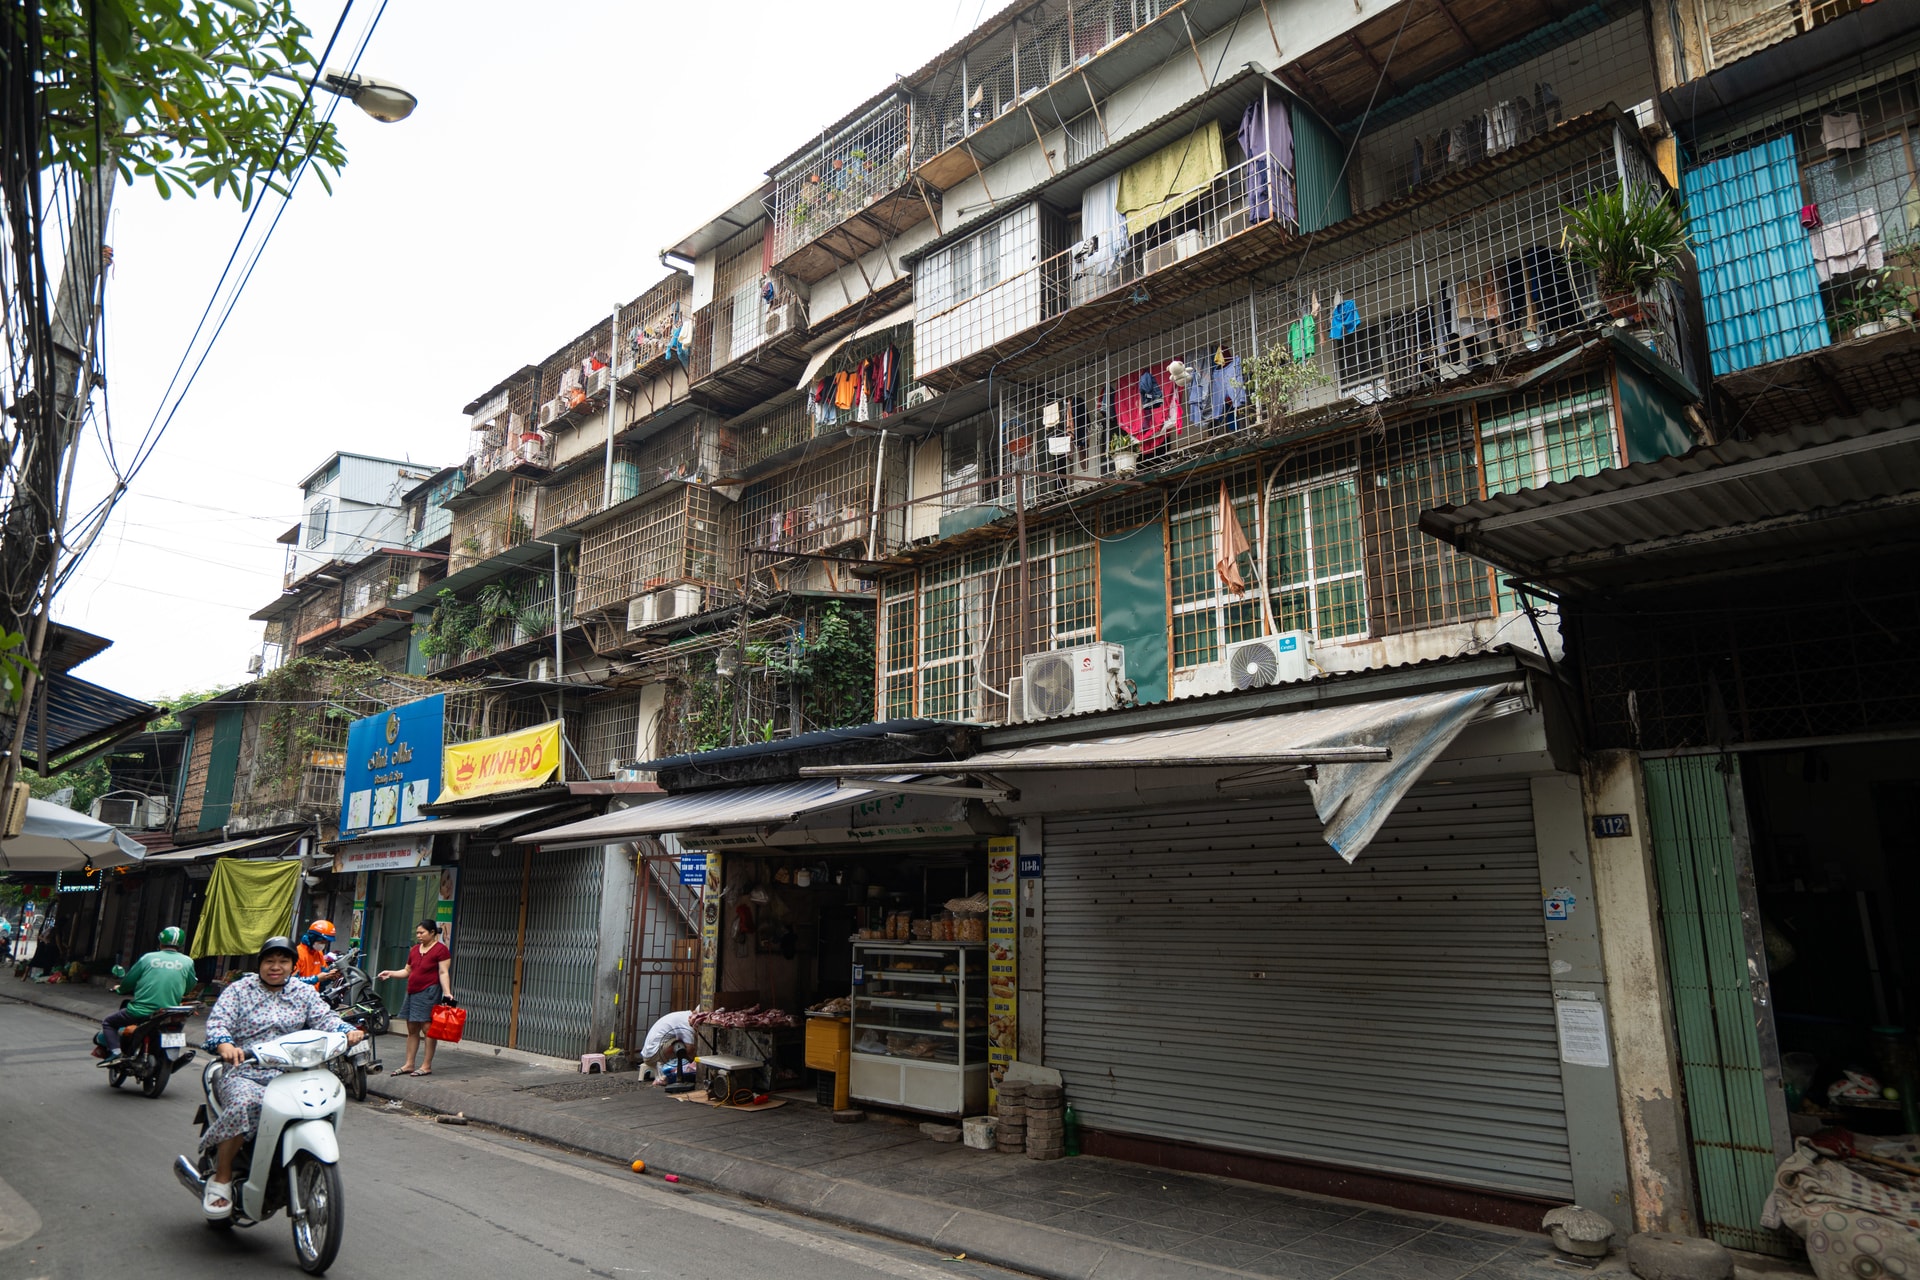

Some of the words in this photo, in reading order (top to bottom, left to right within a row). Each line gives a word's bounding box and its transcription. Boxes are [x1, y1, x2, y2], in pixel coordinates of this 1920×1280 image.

[478, 748, 518, 779] KINH
[519, 736, 542, 772] ĐÔ
[1600, 818, 1623, 834] 112
[151, 958, 183, 970] Grab
